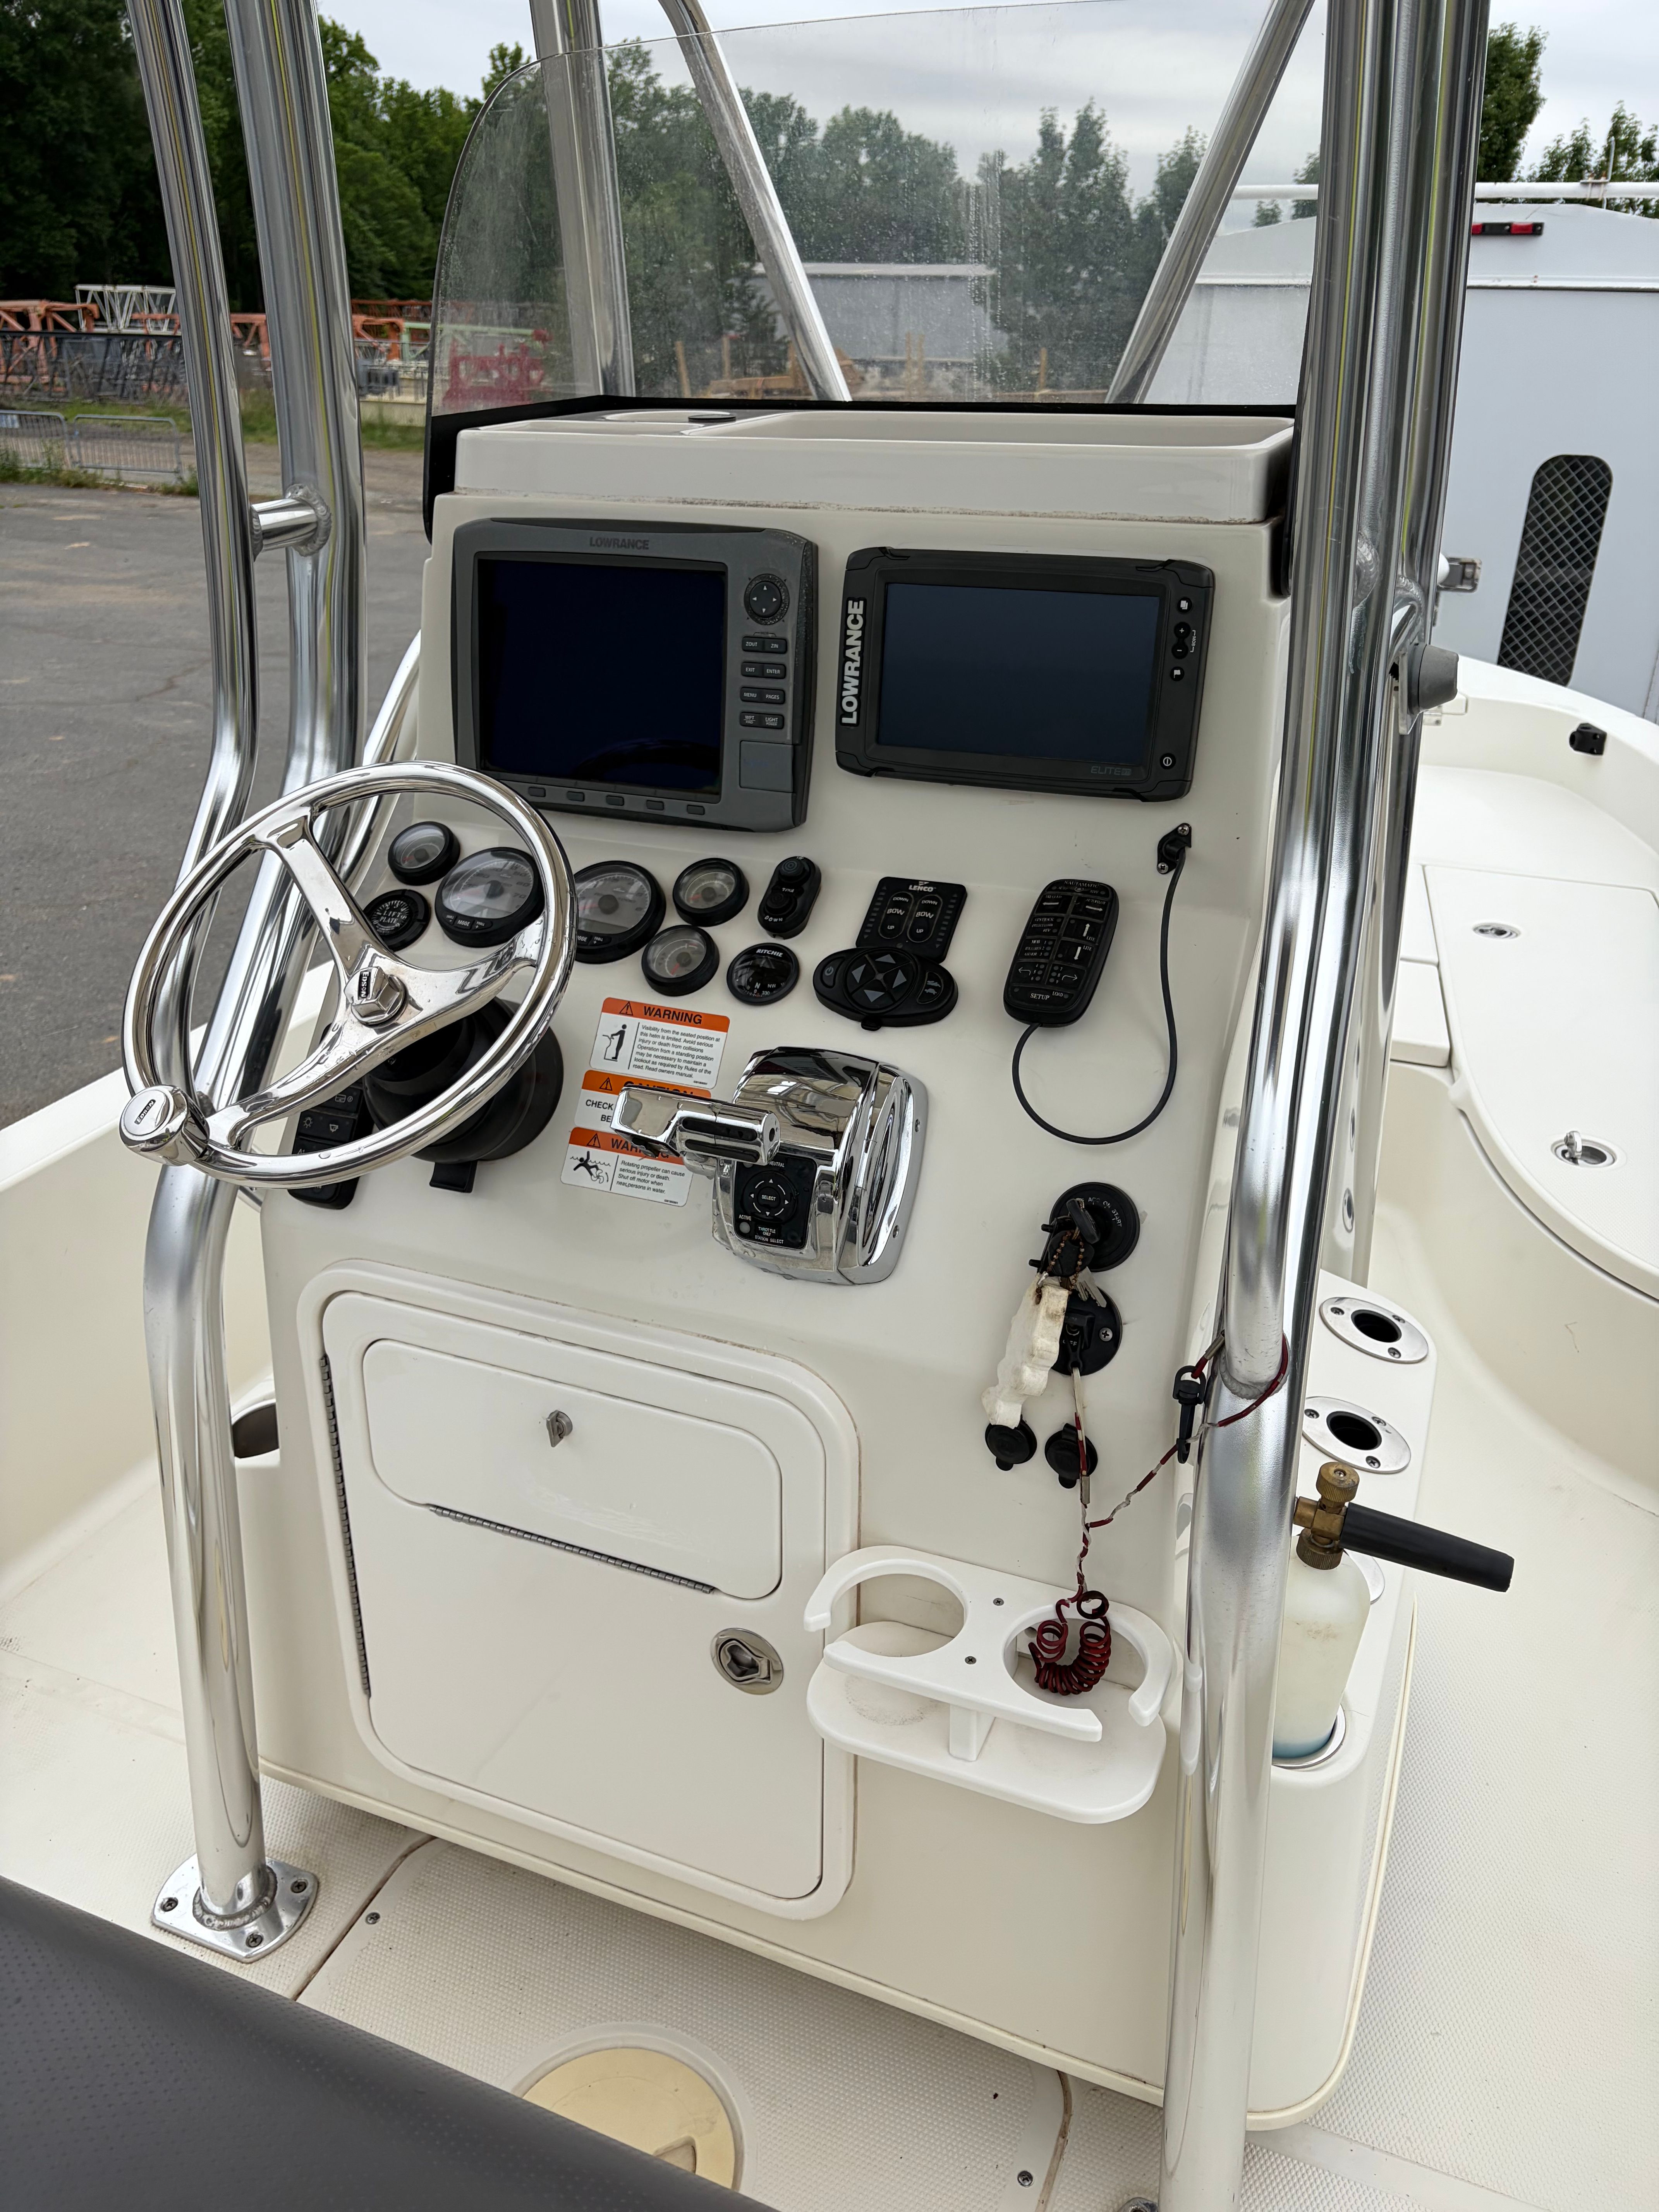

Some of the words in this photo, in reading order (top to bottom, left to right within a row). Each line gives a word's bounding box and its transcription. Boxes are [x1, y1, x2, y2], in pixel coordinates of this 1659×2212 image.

[590, 537, 649, 550] LOWRANCE
[842, 600, 864, 724] LOWRANCE
[1091, 766, 1121, 775] ELITE
[380, 916, 399, 924] PLATE
[756, 948, 783, 957] RITCHIE
[361, 971, 369, 997] EDSON
[644, 1006, 702, 1025] WARNING
[642, 1025, 660, 1033] Visibility
[653, 1054, 677, 1063] necessary
[675, 1051, 695, 1059] standing
[586, 1099, 614, 1111] CHECK
[621, 1160, 640, 1170] Rotating
[640, 1164, 661, 1173] propeller
[1111, 1209, 1122, 1227] START
